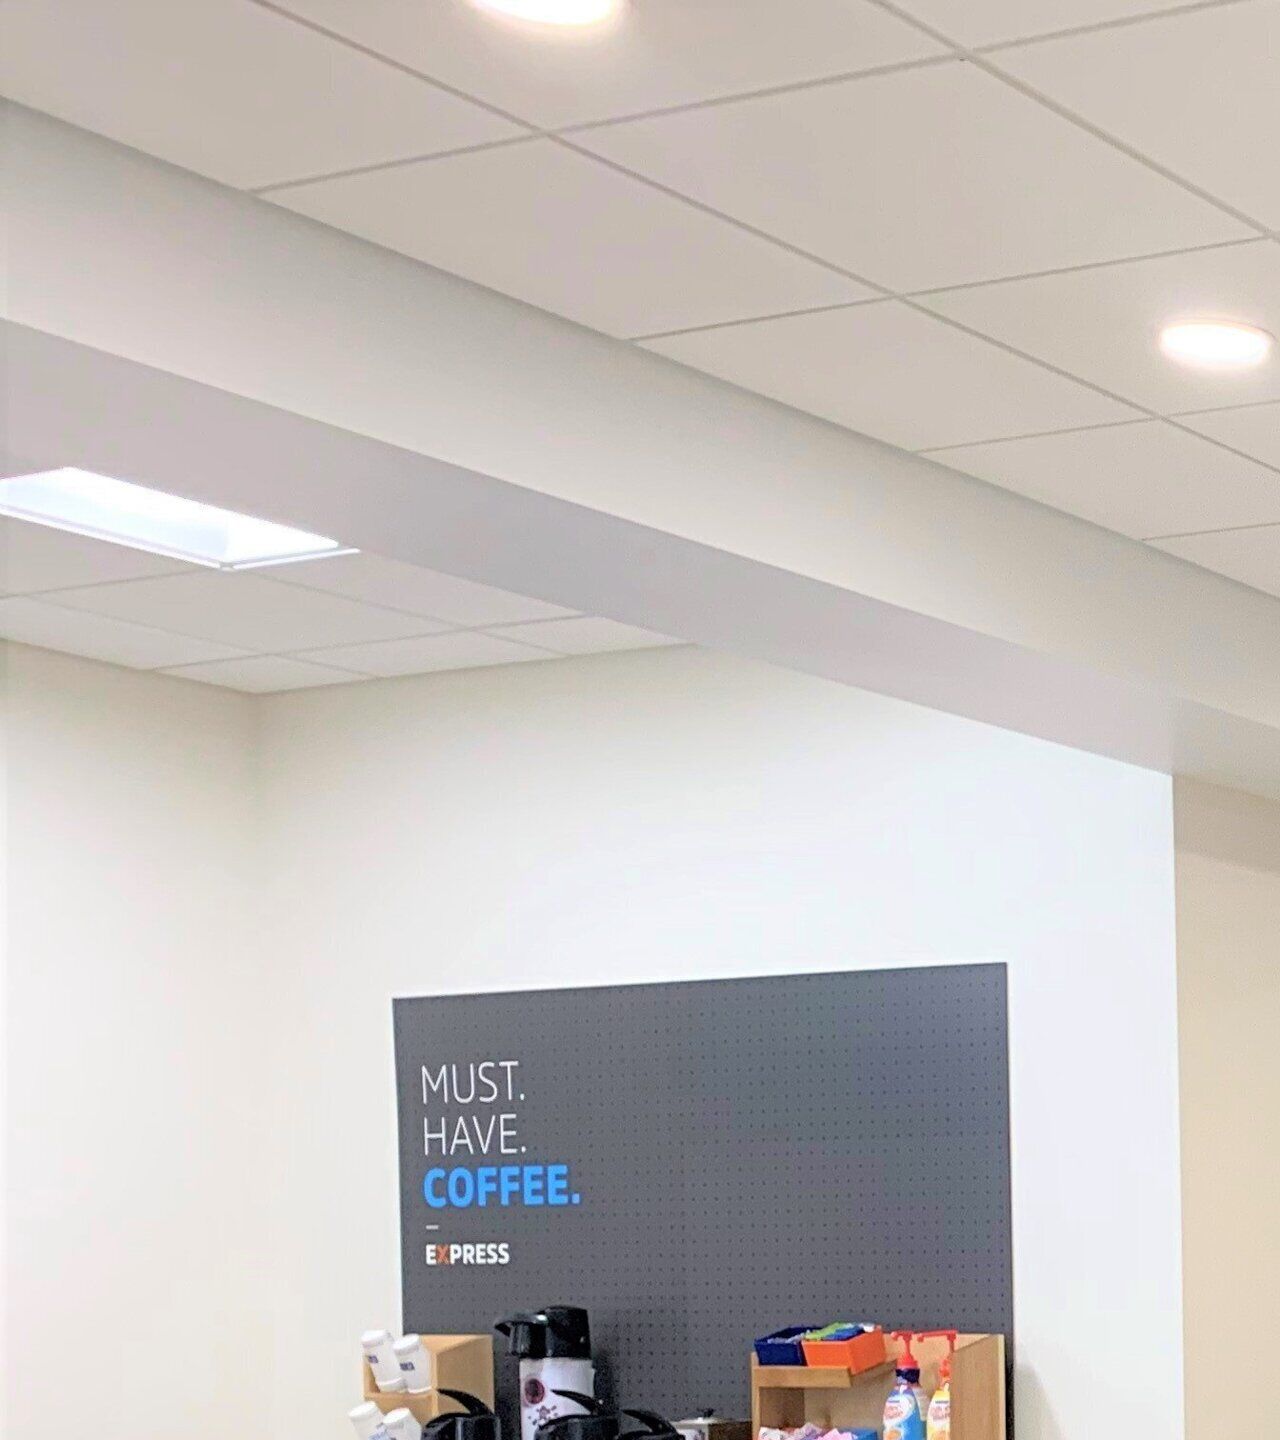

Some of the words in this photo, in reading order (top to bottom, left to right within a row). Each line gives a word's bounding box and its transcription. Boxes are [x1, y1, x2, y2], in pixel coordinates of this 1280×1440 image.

[421, 1060, 525, 1105] MUST.
[423, 1113, 527, 1156] HAVE.
[423, 1164, 581, 1208] COFFEE.
[425, 1242, 510, 1266] EXPRESS
